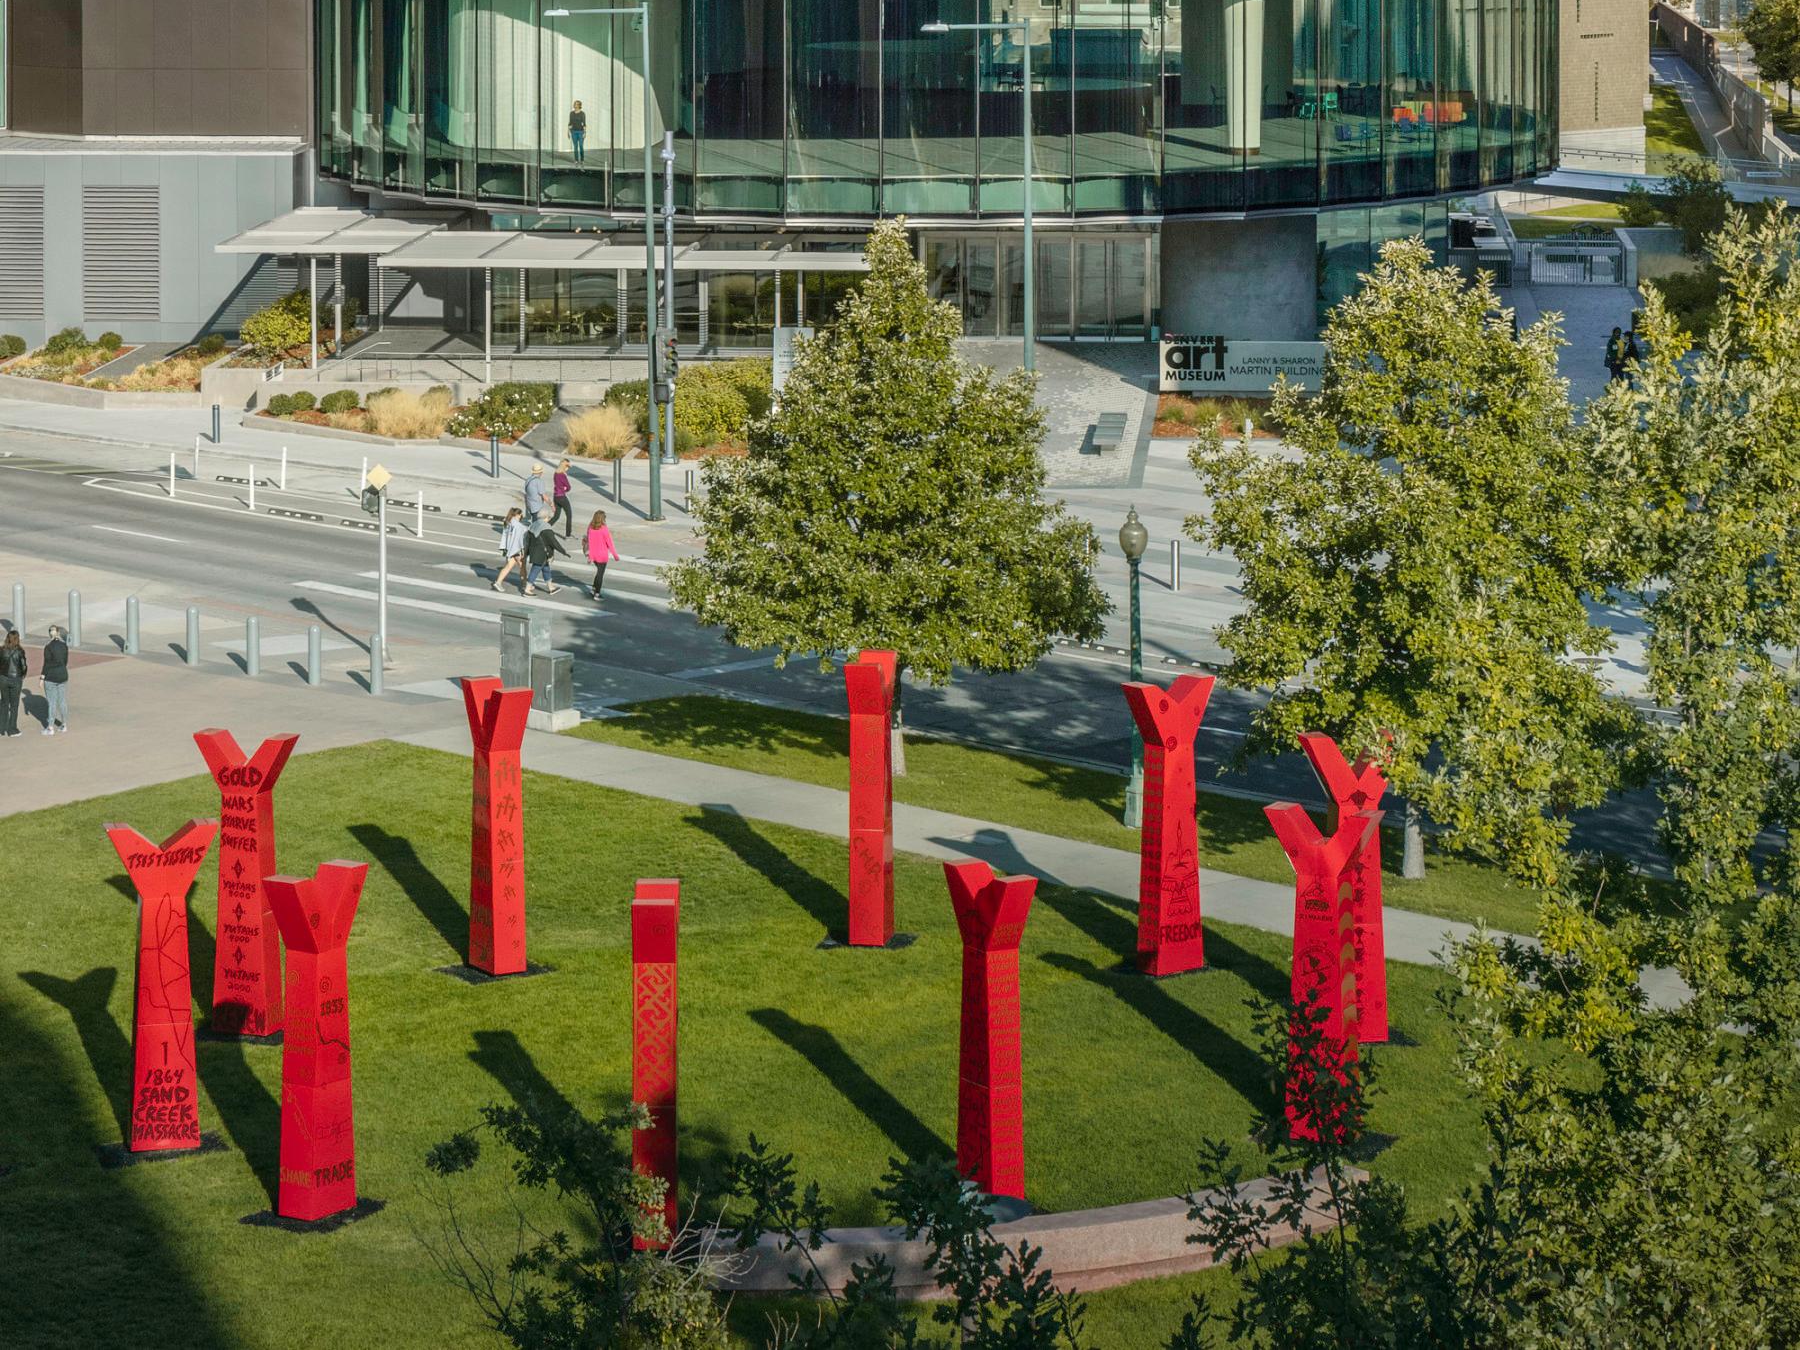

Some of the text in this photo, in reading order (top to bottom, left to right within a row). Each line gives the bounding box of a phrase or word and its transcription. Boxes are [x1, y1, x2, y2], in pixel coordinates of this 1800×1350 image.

[1165, 333, 1216, 345] DENVER
[1165, 335, 1228, 370] art
[1243, 357, 1316, 365] LANNY & SHARON
[1165, 371, 1226, 382] MUSEUM
[1230, 366, 1326, 376] MARTIN BUILDING
[218, 766, 263, 788] GOLD
[222, 794, 254, 813] WARS
[221, 814, 256, 833] STARVE
[221, 832, 257, 853] SUFFER
[144, 1069, 184, 1086] 1864
[137, 1086, 190, 1106] SAND
[134, 1104, 193, 1123] CREEK
[132, 1120, 200, 1142] MASSACRE
[314, 1159, 353, 1188] TRADE
